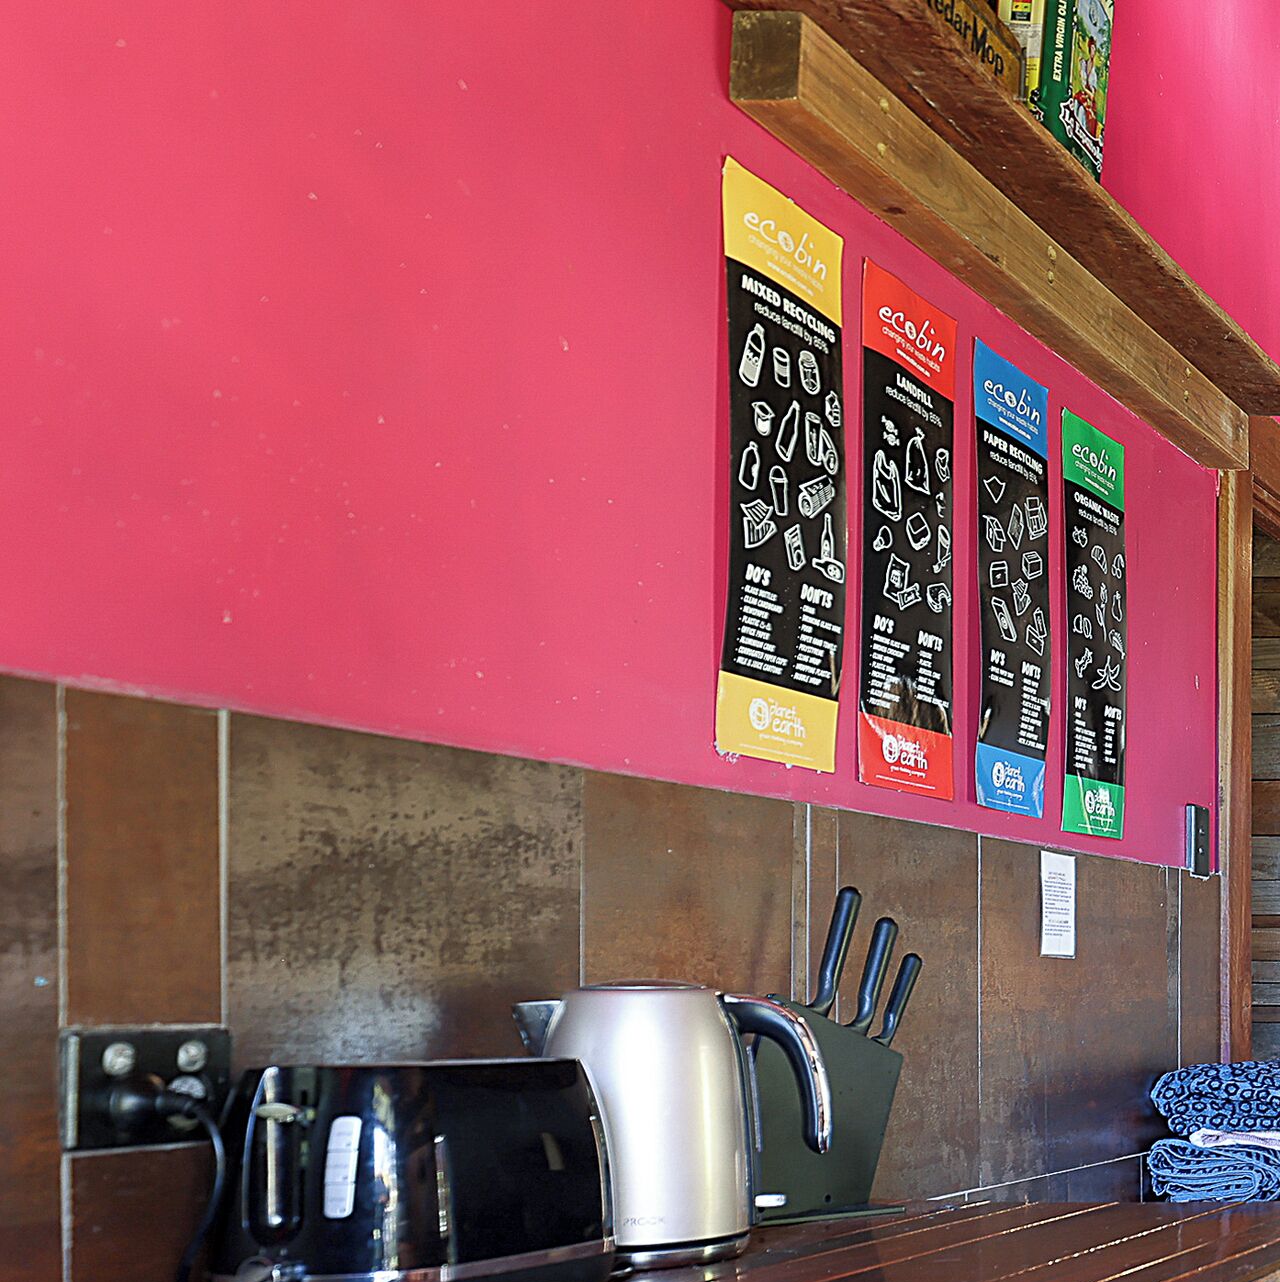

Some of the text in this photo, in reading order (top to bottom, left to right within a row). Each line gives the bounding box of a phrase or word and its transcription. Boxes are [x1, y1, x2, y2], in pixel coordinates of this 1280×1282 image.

[971, 15, 1004, 76] Mop
[1055, 16, 1066, 49] VIRGIN
[1052, 50, 1064, 82] EXTRA
[743, 211, 827, 280] ecobin
[742, 274, 781, 307] MIXED
[783, 298, 836, 344] RECYCLING
[878, 306, 945, 363] ecobin
[896, 373, 934, 409] LANDFILL
[984, 379, 1041, 426] ecobin
[983, 430, 1043, 475] PAPER RECYCLING
[1072, 443, 1117, 481] ecobin
[1074, 491, 1120, 526] ORGANIC WASTE
[745, 563, 771, 587] DO'S
[800, 584, 834, 609] DON'TS
[873, 614, 895, 634] DO'S
[772, 716, 806, 739] earth
[900, 750, 928, 770] earth
